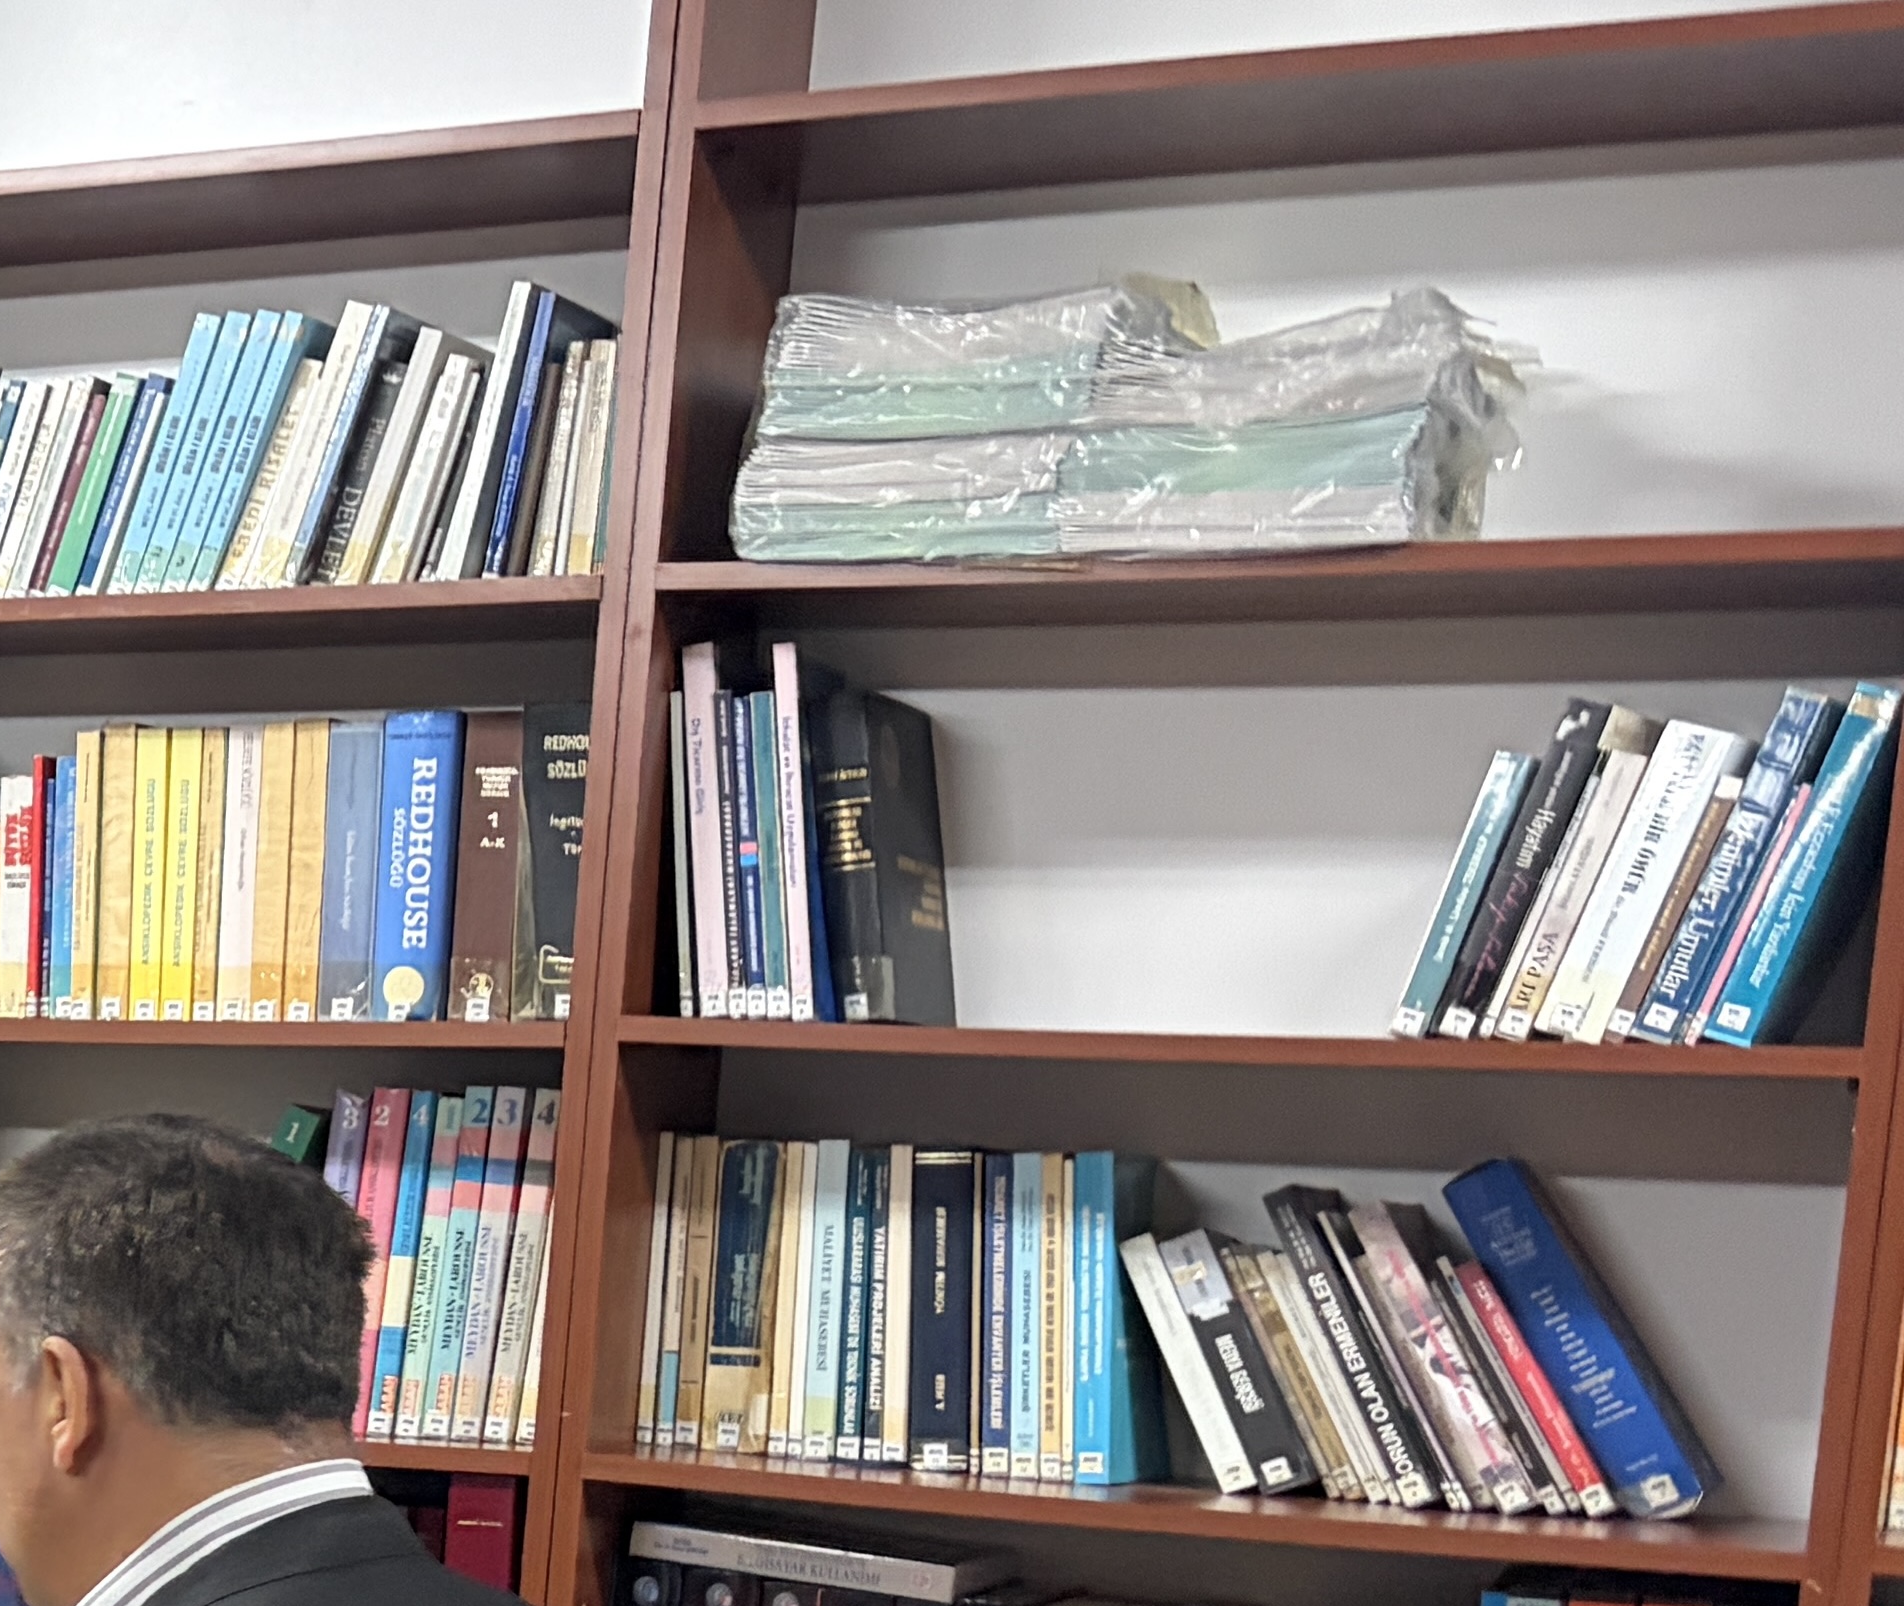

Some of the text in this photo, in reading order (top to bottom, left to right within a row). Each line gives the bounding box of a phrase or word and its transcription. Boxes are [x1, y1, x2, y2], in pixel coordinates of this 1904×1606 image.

[318, 486, 363, 584] DEVLET
[487, 812, 499, 829] 1
[402, 757, 437, 949] REDHOUSE
[1660, 920, 1714, 1001] Umutlar
[343, 1107, 360, 1129] 3
[374, 1104, 390, 1126] 2
[412, 1104, 429, 1127] 4
[471, 1098, 488, 1123] 2
[497, 1104, 517, 1131] 3
[537, 1105, 555, 1126] 4
[285, 1122, 300, 1143] 1
[870, 1226, 885, 1410] YATIRIM PROJELERİ ANALİZİ
[1021, 1270, 1032, 1345] MUHASEBESİ
[1308, 1271, 1420, 1482] ORUN OLAN ERMENİLER
